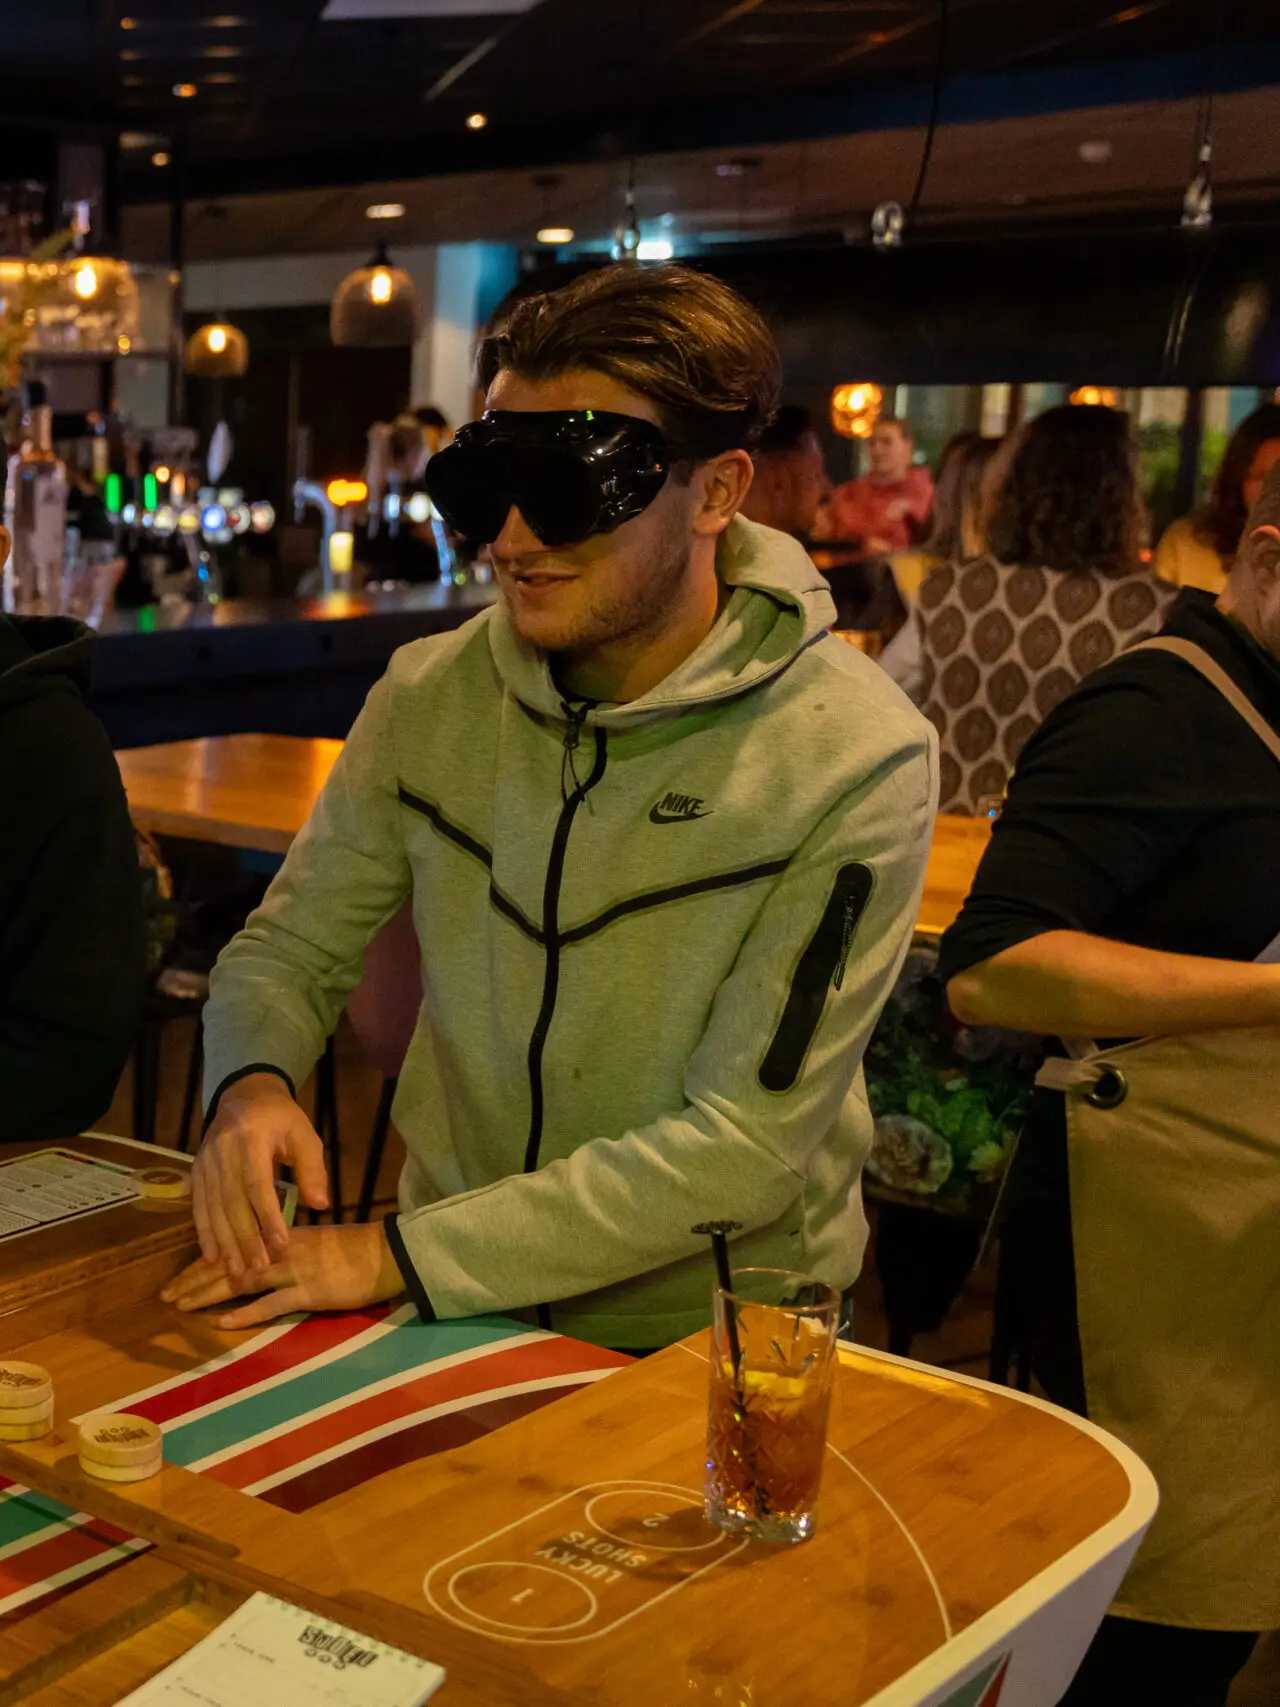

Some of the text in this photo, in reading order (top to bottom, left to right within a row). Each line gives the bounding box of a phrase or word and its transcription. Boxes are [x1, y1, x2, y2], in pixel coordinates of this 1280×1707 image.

[659, 791, 705, 815] NIKE
[533, 1546, 624, 1584] LUCKY
[561, 1531, 648, 1568] SHOTS
